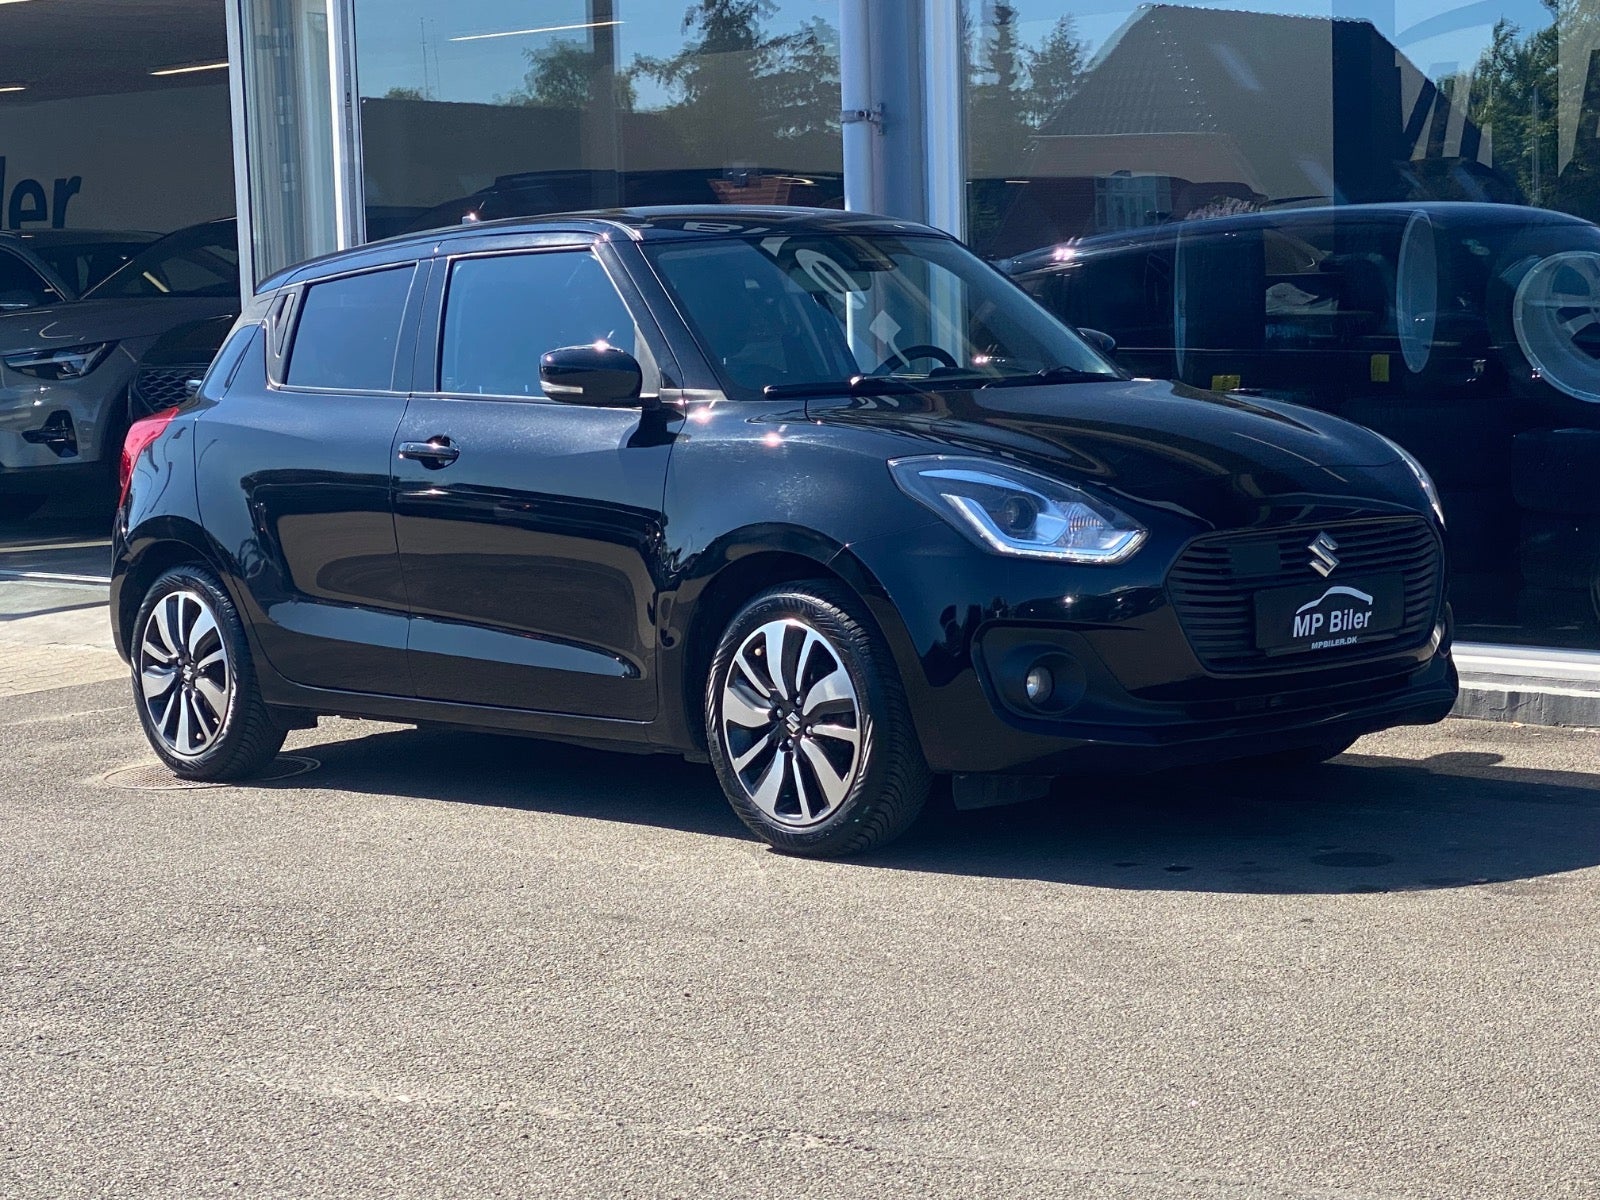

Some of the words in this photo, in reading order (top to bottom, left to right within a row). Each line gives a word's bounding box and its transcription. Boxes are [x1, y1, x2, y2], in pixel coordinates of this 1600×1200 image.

[1293, 613, 1324, 638] MP
[1329, 608, 1373, 633] Biler
[1311, 635, 1358, 650] MPBILER.DK
